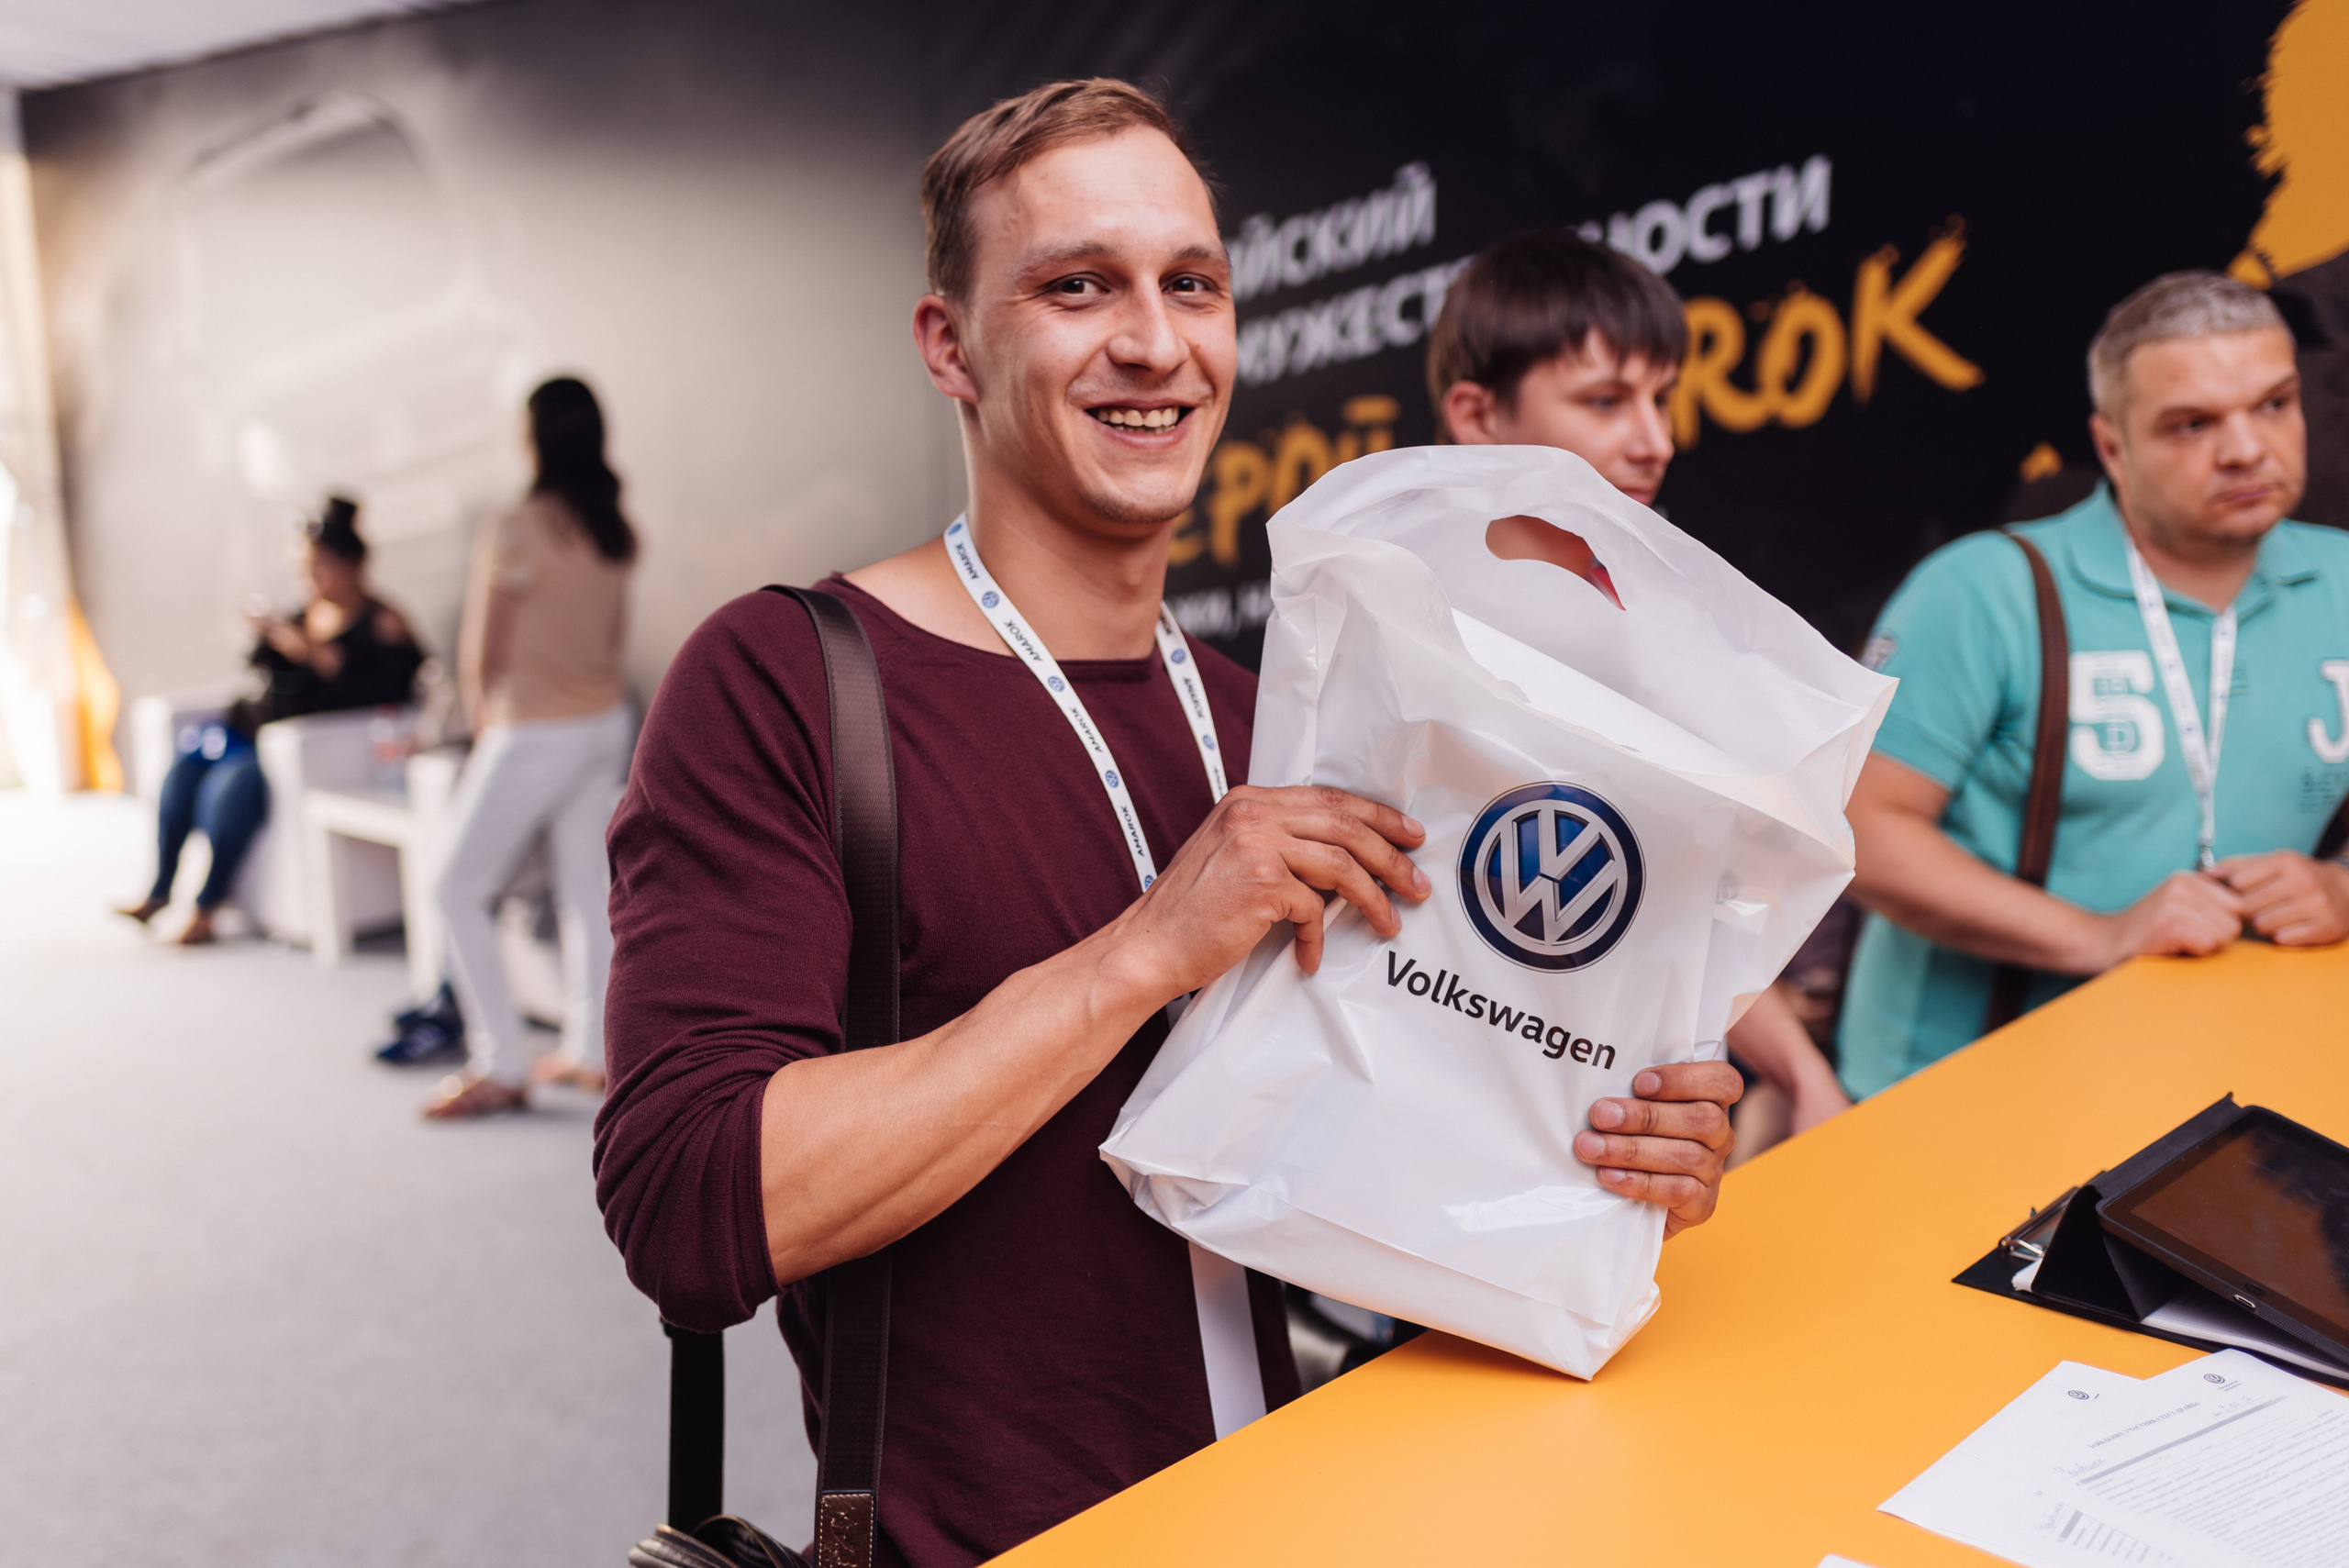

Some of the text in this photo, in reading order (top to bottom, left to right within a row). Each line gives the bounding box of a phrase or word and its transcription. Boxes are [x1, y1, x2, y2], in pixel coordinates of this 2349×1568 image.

[1004, 618, 1044, 662] AMAROK
[1069, 706, 1105, 753] AMAROK
[2068, 650, 2164, 781] 5
[1119, 804, 1145, 857] AMAROK
[1386, 950, 1618, 1071] Volkswagen
